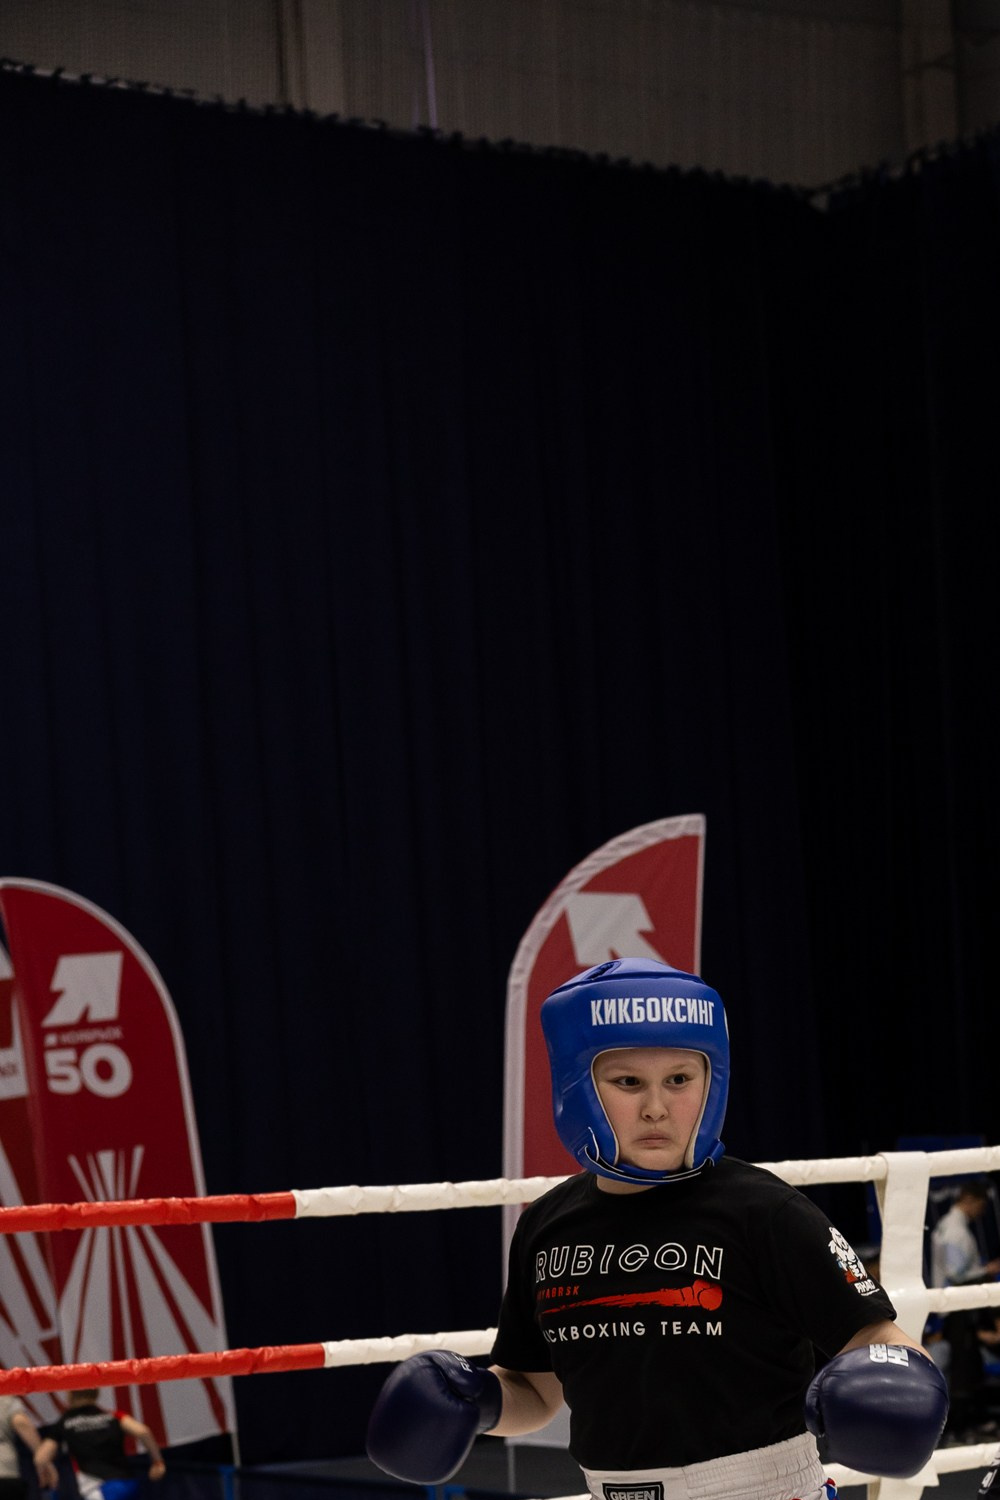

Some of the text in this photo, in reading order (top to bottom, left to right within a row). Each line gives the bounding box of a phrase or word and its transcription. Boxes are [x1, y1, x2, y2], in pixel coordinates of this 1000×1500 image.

[591, 997, 715, 1027] КИКБОКСИНГ
[44, 1042, 133, 1098] 50
[535, 1242, 724, 1283] RUBICON
[537, 1285, 580, 1301] YABRSK
[542, 1321, 722, 1343] ICKBOXING TEAM
